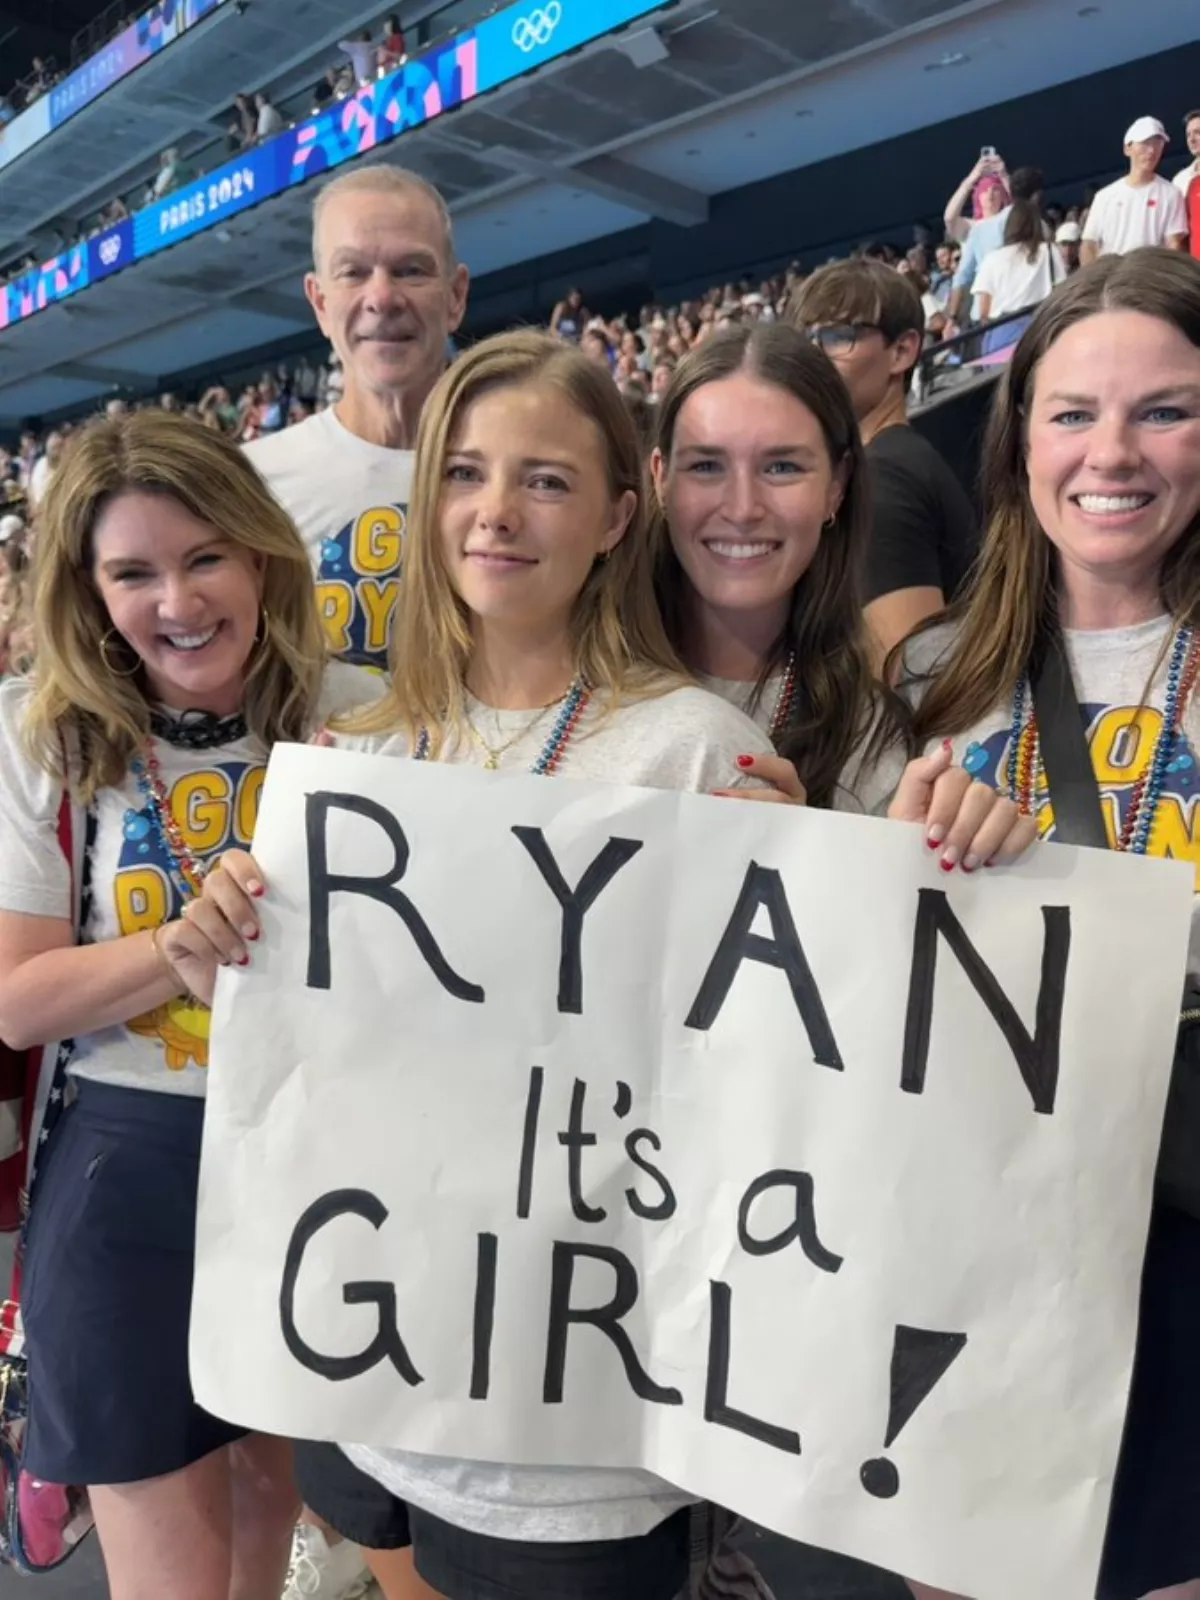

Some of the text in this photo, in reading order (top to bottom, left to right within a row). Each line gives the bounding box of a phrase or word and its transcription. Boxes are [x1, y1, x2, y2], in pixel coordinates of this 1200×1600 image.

[160, 167, 255, 235] PARIS 2024
[351, 506, 406, 577] G
[314, 577, 402, 654] RY
[307, 793, 1071, 1115] RYAN
[517, 1066, 843, 1273] It's a
